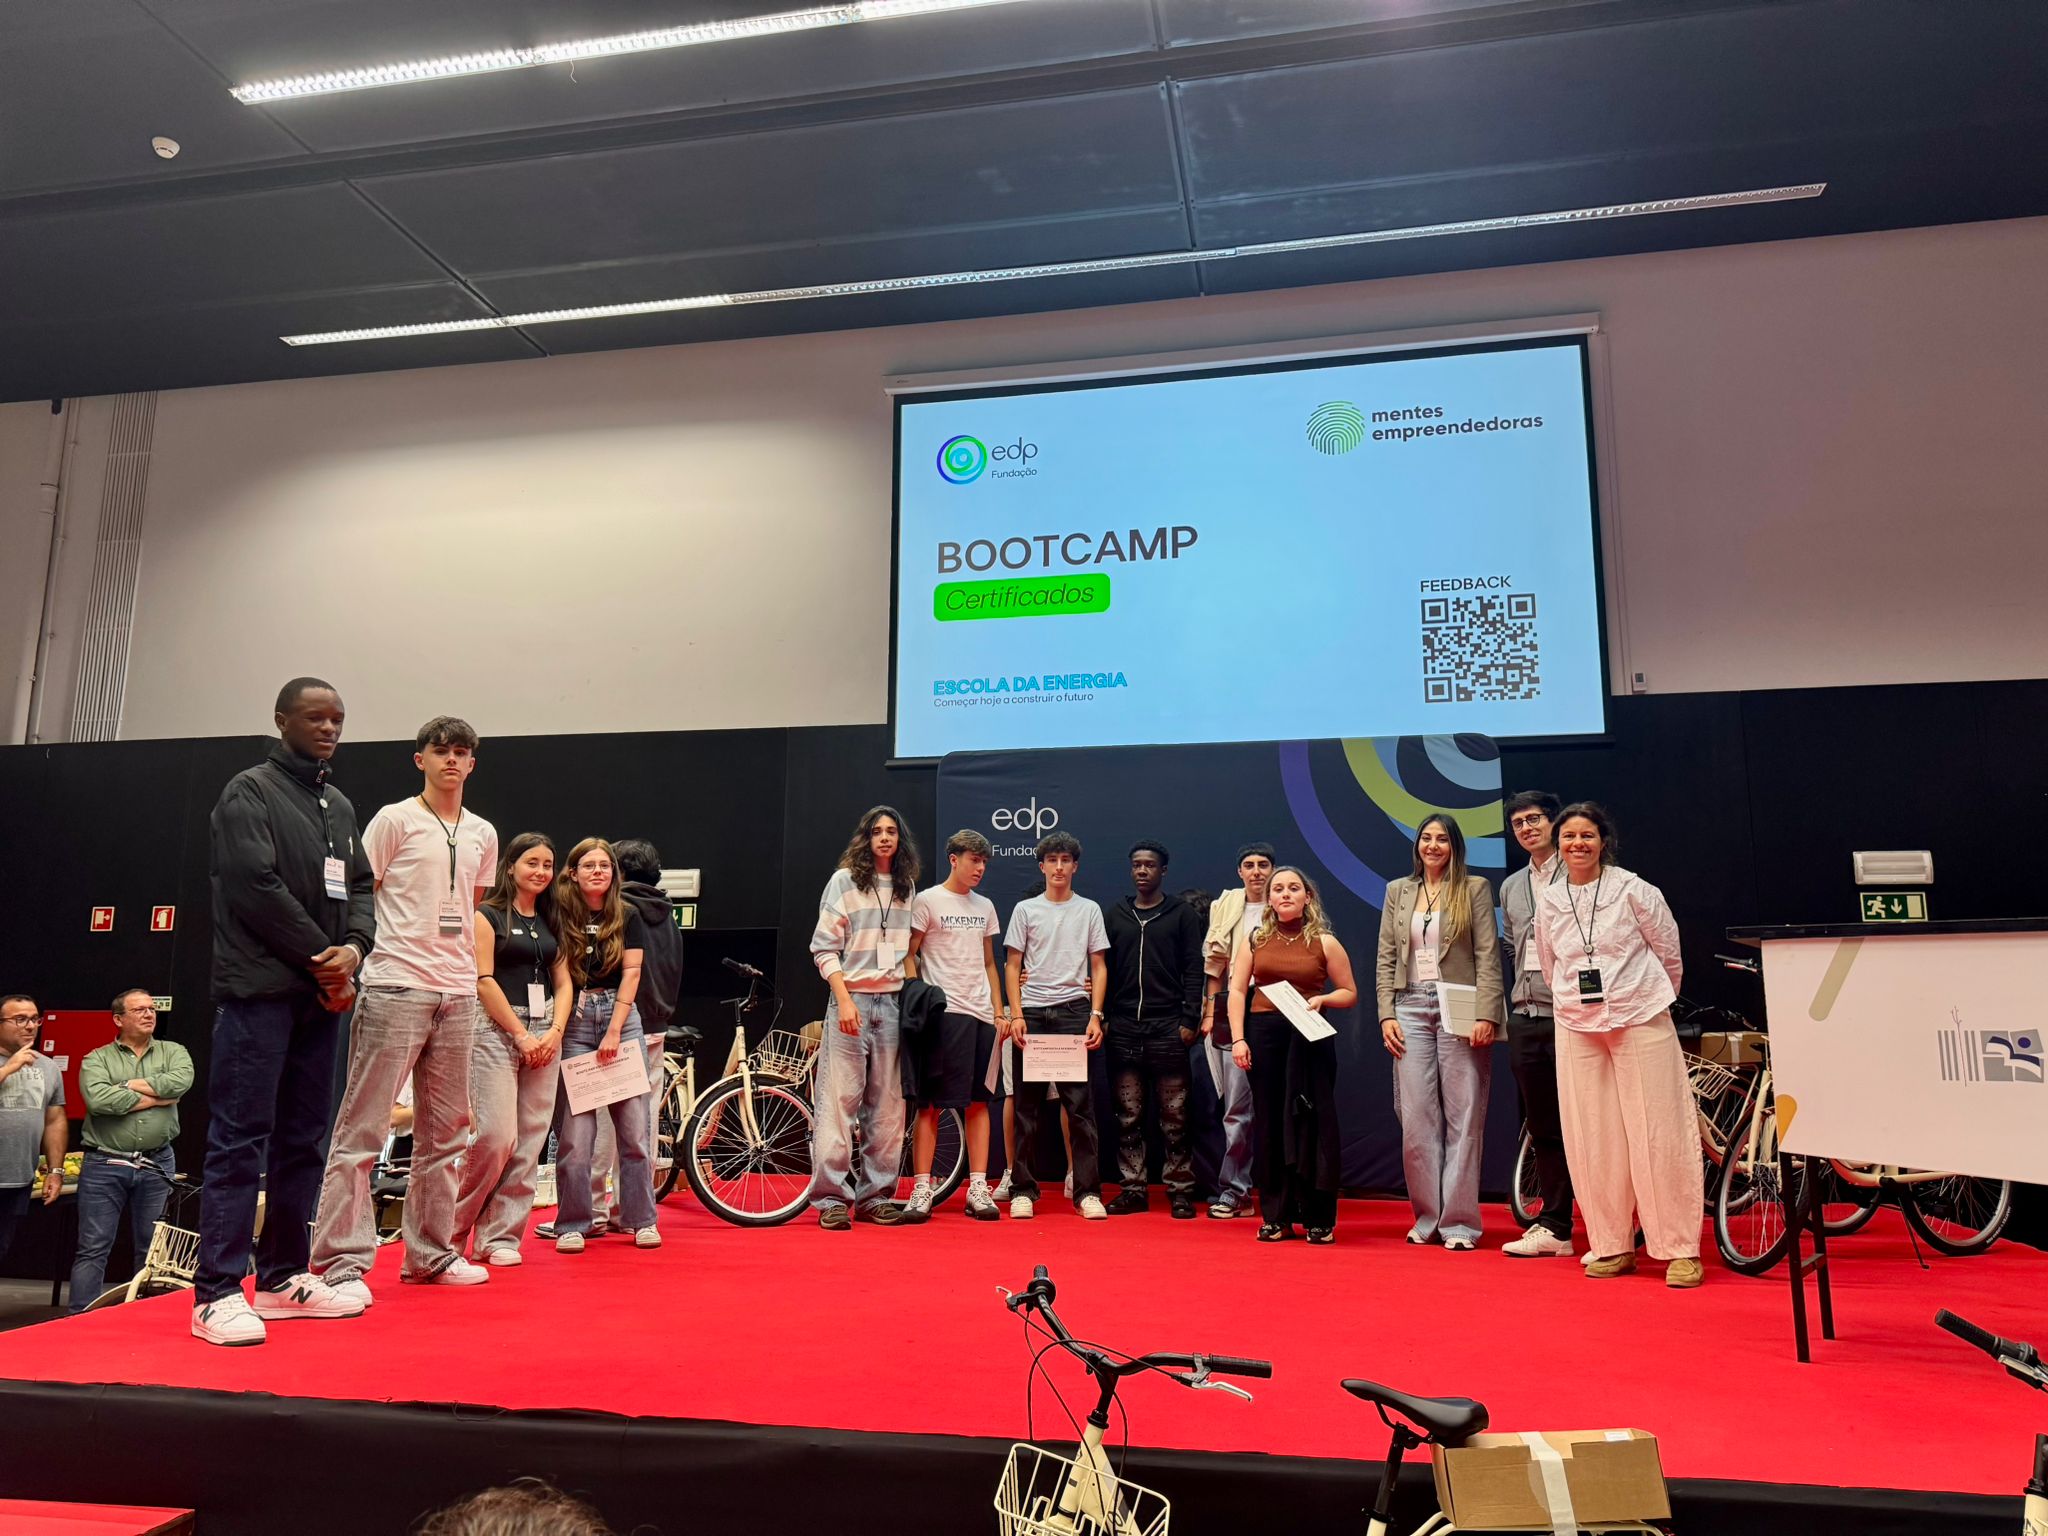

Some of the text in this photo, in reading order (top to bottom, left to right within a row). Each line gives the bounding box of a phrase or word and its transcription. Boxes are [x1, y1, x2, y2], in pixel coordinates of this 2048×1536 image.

[1371, 406, 1443, 423] mentes
[1372, 416, 1544, 442] empreendedoras
[991, 436, 1038, 465] edp
[991, 467, 1038, 479] Fundação
[938, 525, 1198, 574] BOOTCAMP
[1420, 575, 1512, 592] FEEDBACK
[946, 583, 1094, 610] Certificados
[933, 671, 1128, 695] ESCOLA DA ENERGIA
[934, 697, 978, 708] Começar
[980, 695, 1001, 706] hoje
[1011, 693, 1054, 704] construir
[1064, 692, 1094, 702] futuro
[991, 796, 1059, 839] edp
[991, 844, 1038, 859] Fundaç
[940, 915, 986, 926] MCKENZIE
[290, 1286, 313, 1304] N
[199, 1304, 216, 1323] N
